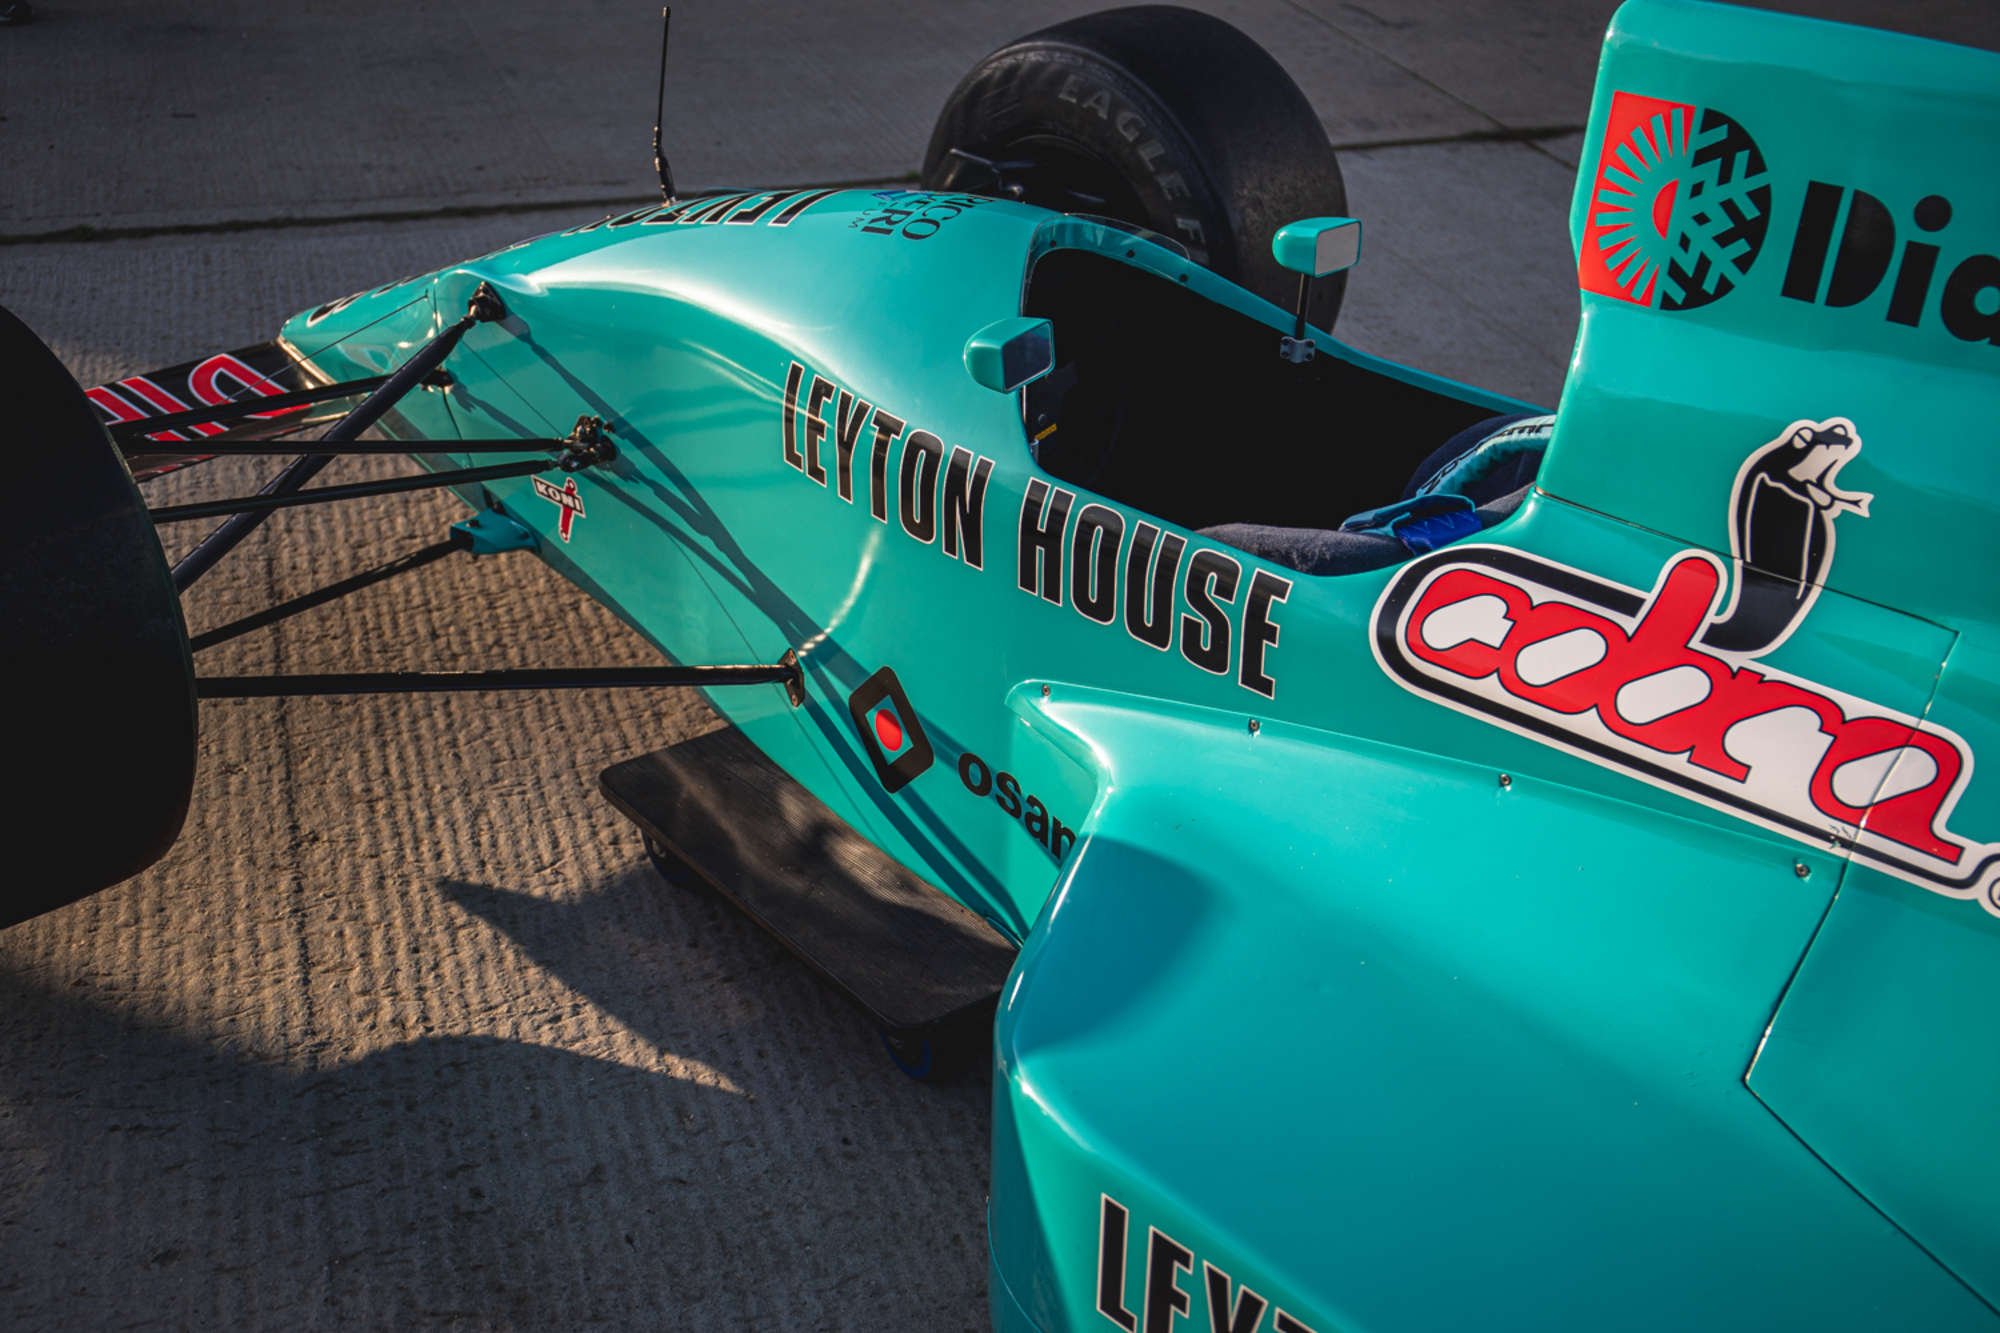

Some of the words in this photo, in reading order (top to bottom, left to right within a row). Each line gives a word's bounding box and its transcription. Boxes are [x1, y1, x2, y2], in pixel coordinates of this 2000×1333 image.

[1057, 73, 1192, 202] EAGLE
[534, 479, 583, 513] KONI
[783, 360, 996, 571] LEYTON
[1017, 476, 1295, 700] HOUSE
[1405, 556, 1966, 865] cobra
[1096, 1191, 1318, 1333] LEY
